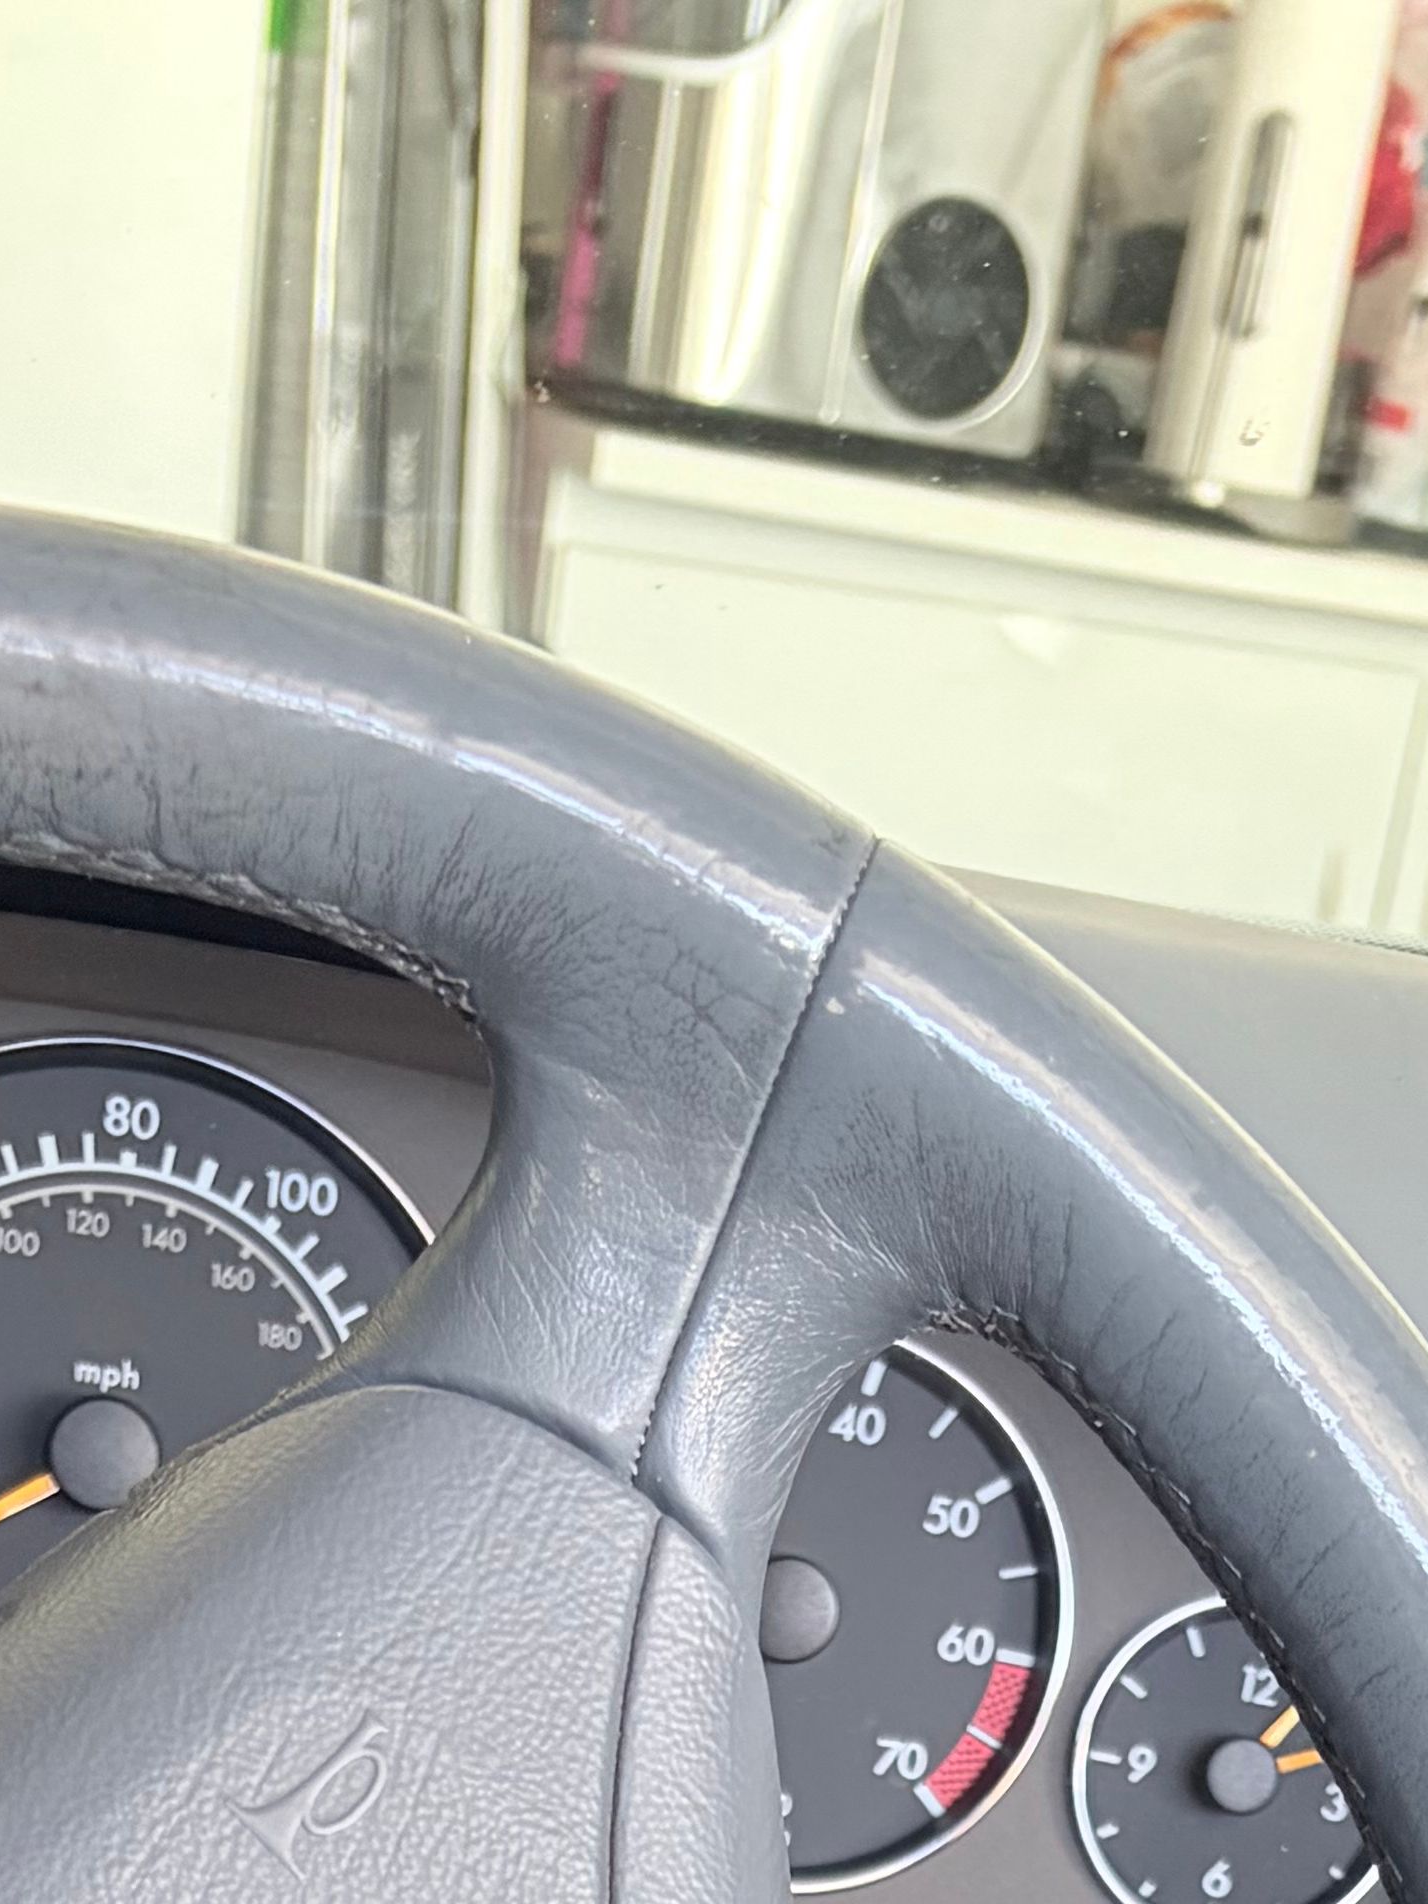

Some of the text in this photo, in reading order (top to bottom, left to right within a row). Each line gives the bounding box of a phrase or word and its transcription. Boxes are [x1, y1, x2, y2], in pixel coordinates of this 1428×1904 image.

[103, 1097, 160, 1139] 80
[267, 1169, 338, 1216] 100
[66, 1211, 109, 1239] 120
[141, 1224, 187, 1255] 140
[211, 1263, 255, 1293] 160
[258, 1321, 302, 1350] 180
[73, 1361, 140, 1392] mph
[830, 1407, 886, 1447] 40
[922, 1495, 979, 1538] 50
[936, 1628, 994, 1666] 60
[1241, 1664, 1280, 1707] 12
[874, 1739, 927, 1781] 70
[1126, 1747, 1157, 1783] 9
[1320, 1782, 1350, 1823] 3
[1201, 1861, 1233, 1897] 6
